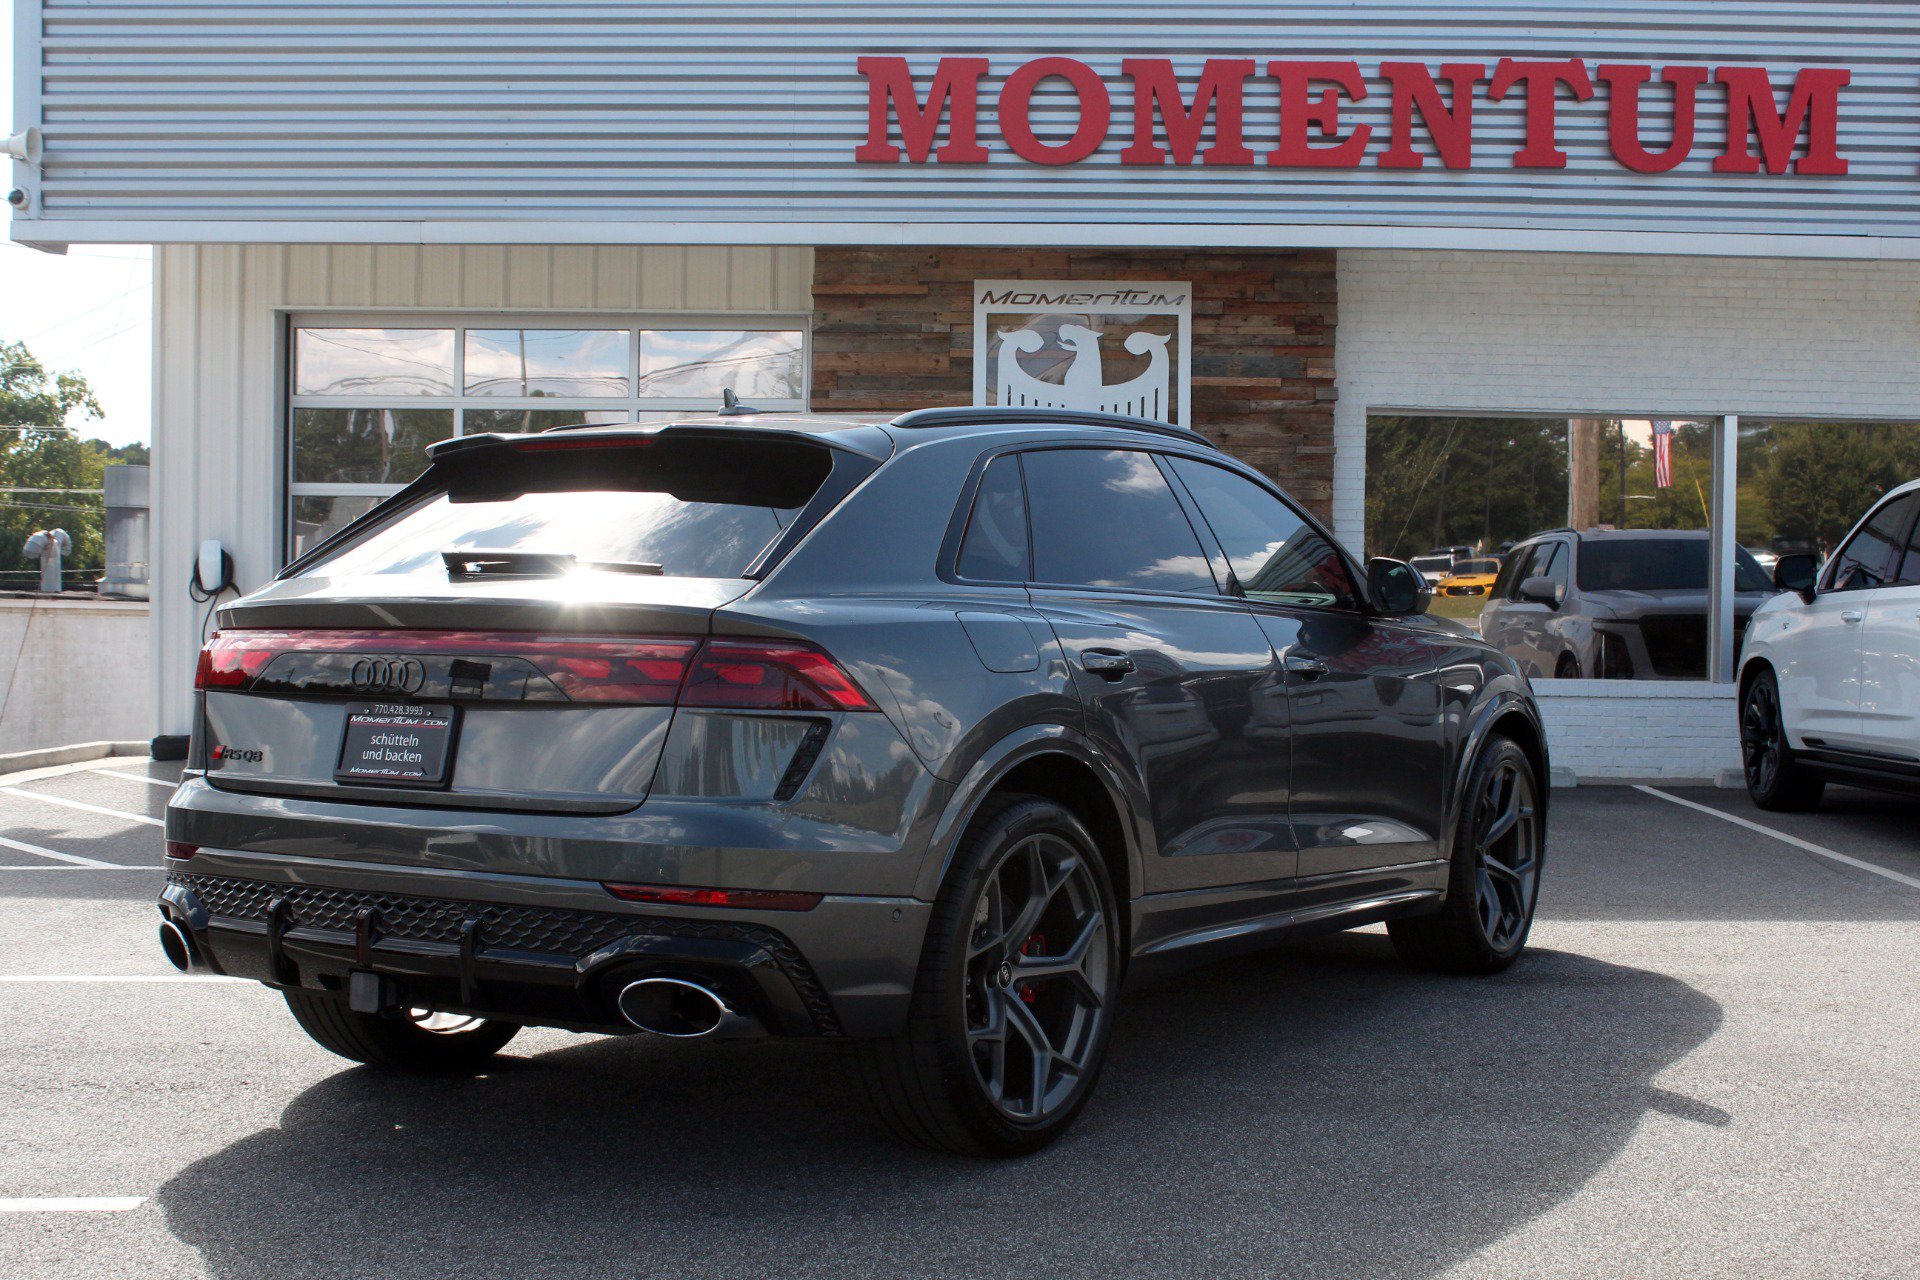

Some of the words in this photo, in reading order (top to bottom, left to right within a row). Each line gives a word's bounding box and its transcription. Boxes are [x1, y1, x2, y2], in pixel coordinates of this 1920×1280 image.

[856, 56, 1850, 175] MOMENTUM
[375, 704, 423, 715] 770.428.3993
[370, 733, 418, 746] schütteln
[243, 750, 263, 762] Q8
[362, 748, 382, 760] und
[385, 749, 421, 762] backen
